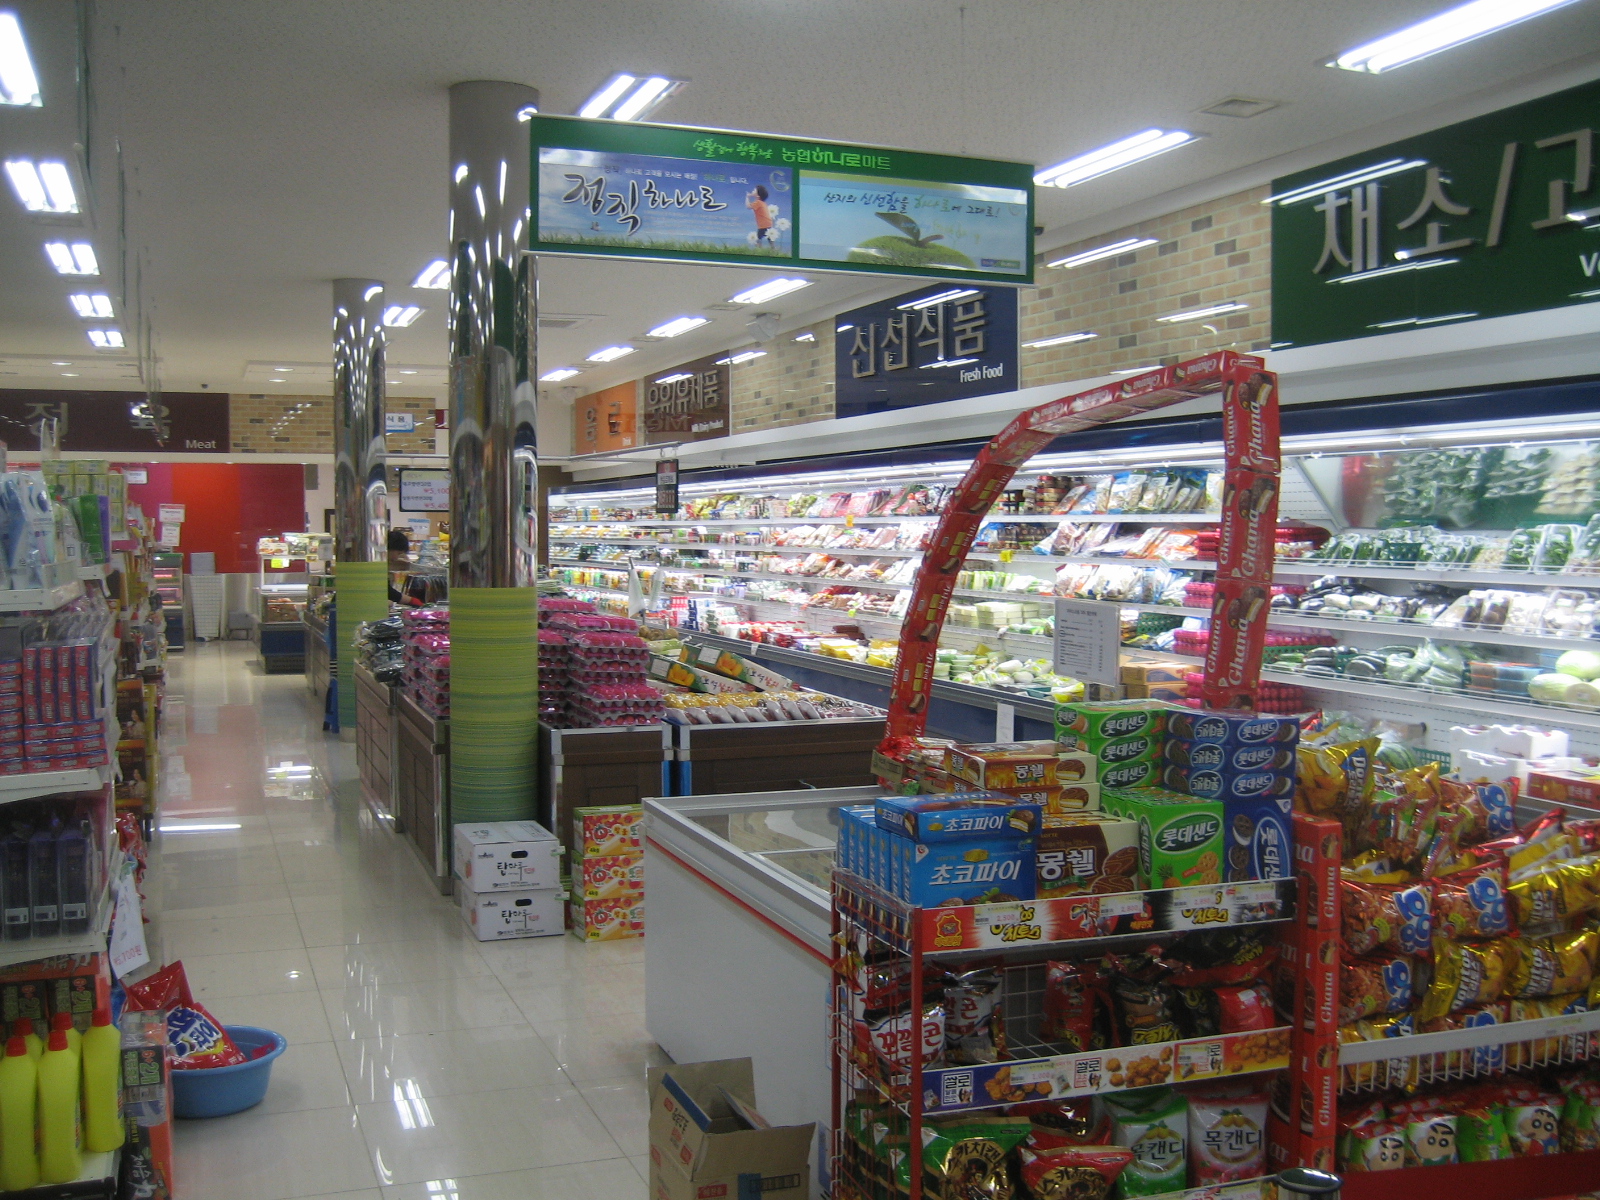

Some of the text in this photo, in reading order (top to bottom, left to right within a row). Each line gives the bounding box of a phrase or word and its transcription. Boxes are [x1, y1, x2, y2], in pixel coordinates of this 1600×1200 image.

[782, 147, 891, 170] 농협하나로마트
[562, 173, 642, 236] 정직
[643, 179, 728, 212] 하나로
[960, 363, 1004, 384] Fresh Food
[1226, 405, 1237, 457] Ghana
[1250, 401, 1264, 465] Ghana
[185, 440, 217, 449] Meat
[1219, 511, 1233, 565] Ghana
[1241, 508, 1260, 577] Ghana
[1207, 619, 1222, 674] Ghana
[1228, 617, 1250, 686] Ghana
[1104, 715, 1147, 735] 롯데샌드
[1242, 722, 1275, 739] 롯데샌드
[1105, 740, 1147, 760] 롯데샌드
[1238, 749, 1272, 765] 롯데샌드
[1014, 763, 1045, 779] 몽쉘
[1106, 765, 1147, 786] 롯데샌드
[1237, 775, 1271, 792] 롯데샌드
[881, 809, 904, 827] 초코파이
[944, 815, 1004, 833] 초코파이
[1160, 820, 1218, 850] 롯데샌드
[1037, 849, 1096, 880] 몽쉘
[1259, 826, 1282, 880] 롯데샌
[929, 859, 1022, 886] 초코파이
[1323, 866, 1336, 919] Ghana
[1192, 908, 1229, 924] 치토스
[1001, 924, 1042, 942] 치토스
[1320, 971, 1334, 1024] Ghana
[1318, 1074, 1332, 1127] Ghana
[1131, 1138, 1186, 1161] 목캔디
[1202, 1129, 1263, 1152] 목캔디
